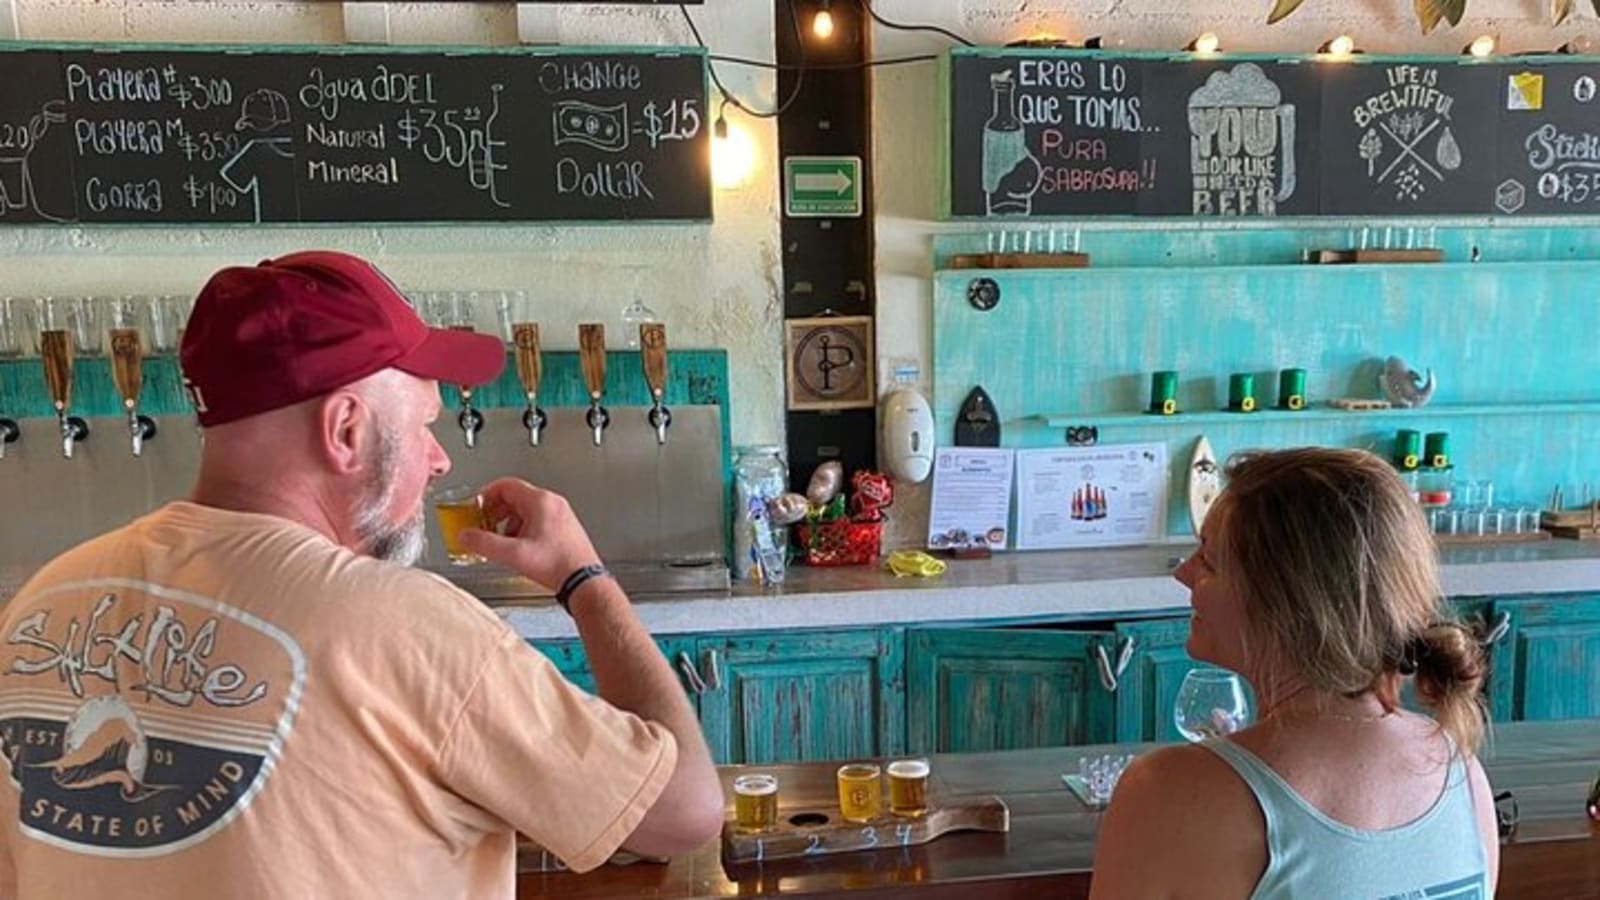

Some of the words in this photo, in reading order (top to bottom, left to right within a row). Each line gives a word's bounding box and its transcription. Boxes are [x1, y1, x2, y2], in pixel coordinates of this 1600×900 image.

[1099, 62, 1126, 93] LO
[1386, 64, 1419, 87] LIFE
[1422, 68, 1438, 86] IS
[1353, 84, 1455, 128] BREWTIFUL
[1042, 128, 1107, 160] PURA
[1188, 107, 1278, 157] YOU
[1243, 156, 1276, 178] LIKE
[182, 174, 237, 214] $100
[25, 729, 59, 747] EST
[30, 798, 123, 837] STATE
[134, 816, 166, 837] OF
[175, 760, 244, 827] MIND
[755, 838, 764, 861] 1
[804, 833, 827, 855] 2
[861, 826, 879, 848] 3
[895, 823, 913, 846] 4
